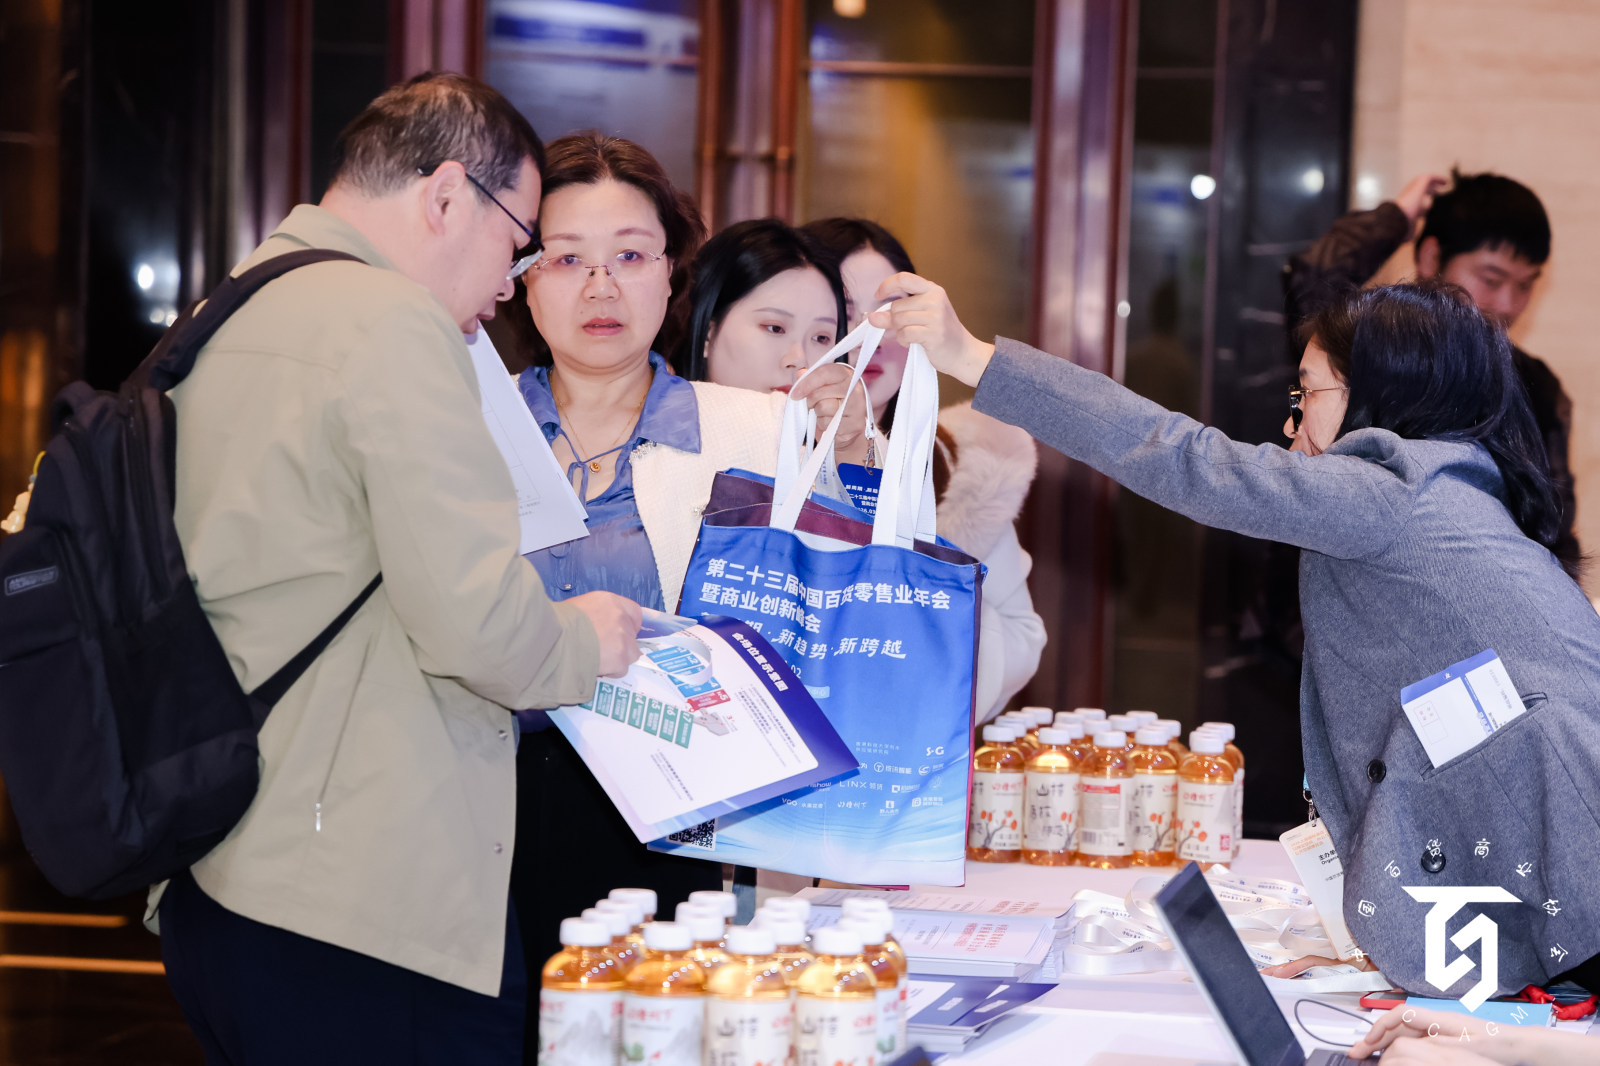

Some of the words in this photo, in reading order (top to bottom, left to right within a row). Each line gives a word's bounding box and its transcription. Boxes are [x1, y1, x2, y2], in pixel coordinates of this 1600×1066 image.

[705, 558, 951, 610] 第二十三届中国百货零售业年会
[699, 582, 821, 633] 暨商业创新峰会
[839, 780, 867, 789] LINX
[1318, 849, 1336, 860] 主办单
